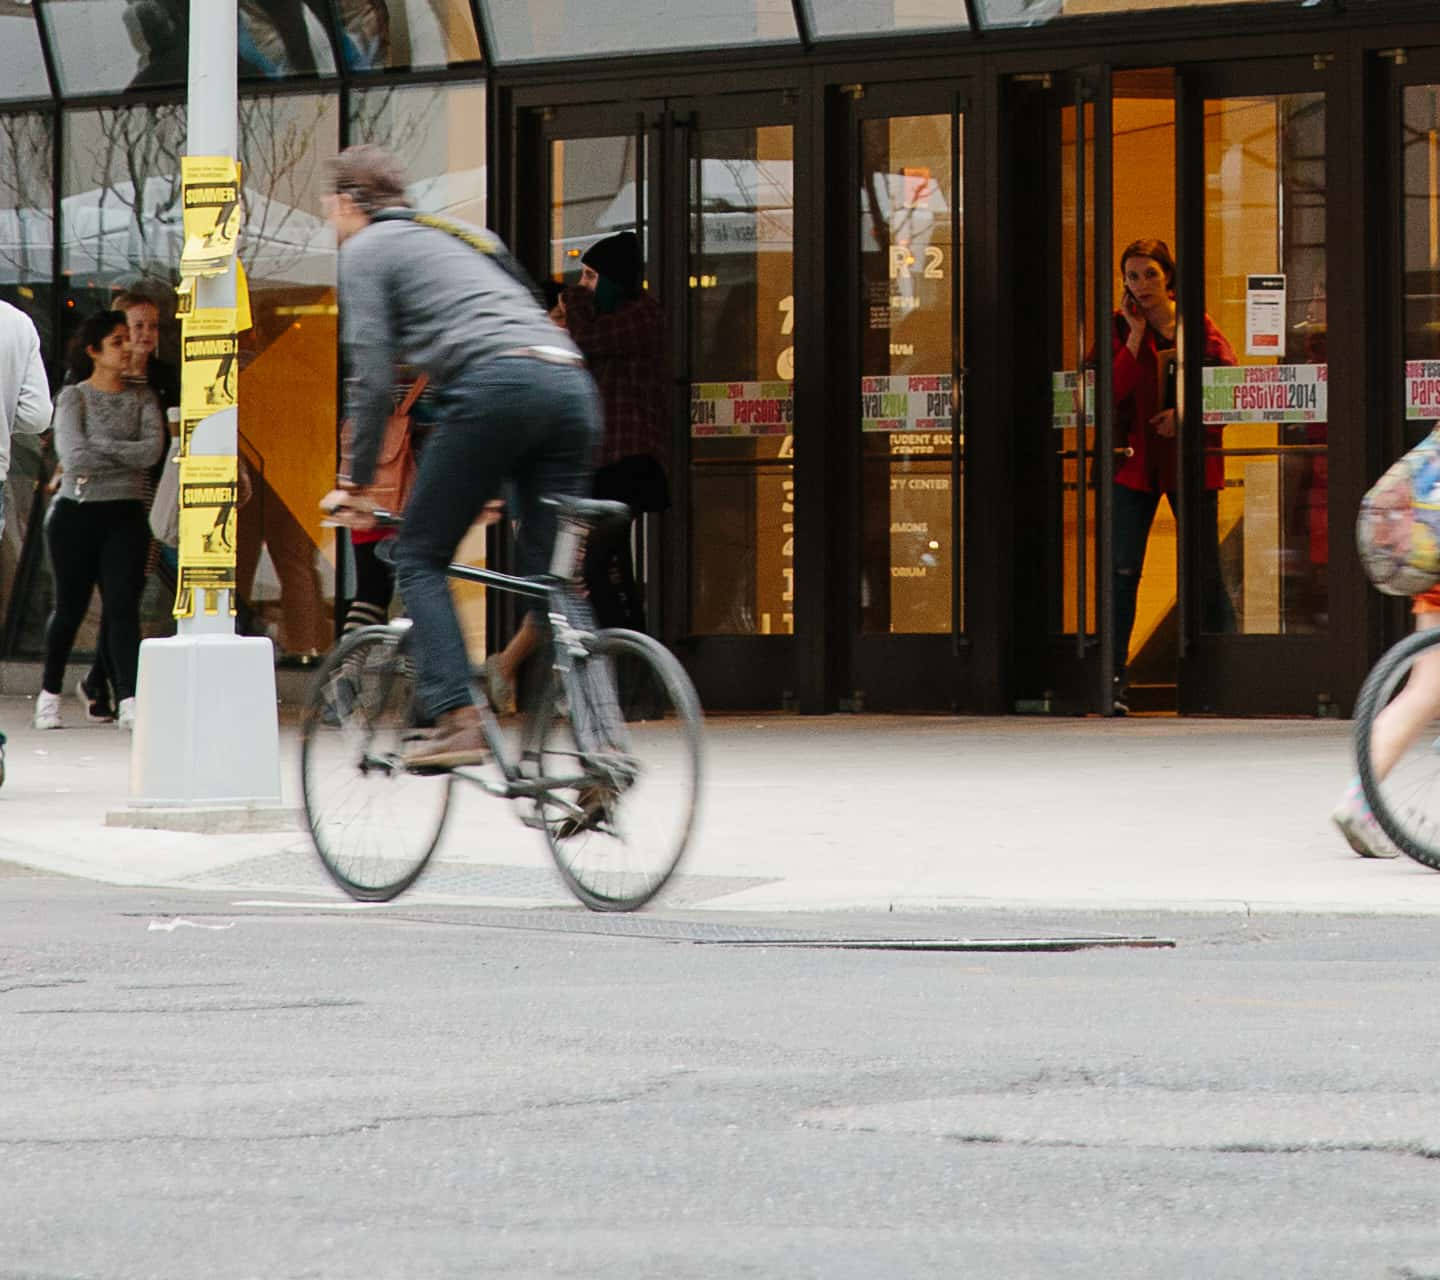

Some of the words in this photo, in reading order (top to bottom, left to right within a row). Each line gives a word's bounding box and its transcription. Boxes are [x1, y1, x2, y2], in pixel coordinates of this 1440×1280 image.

[186, 187, 236, 204] SUMMER
[185, 340, 234, 357] SUMMER
[184, 487, 232, 504] SUMMER
